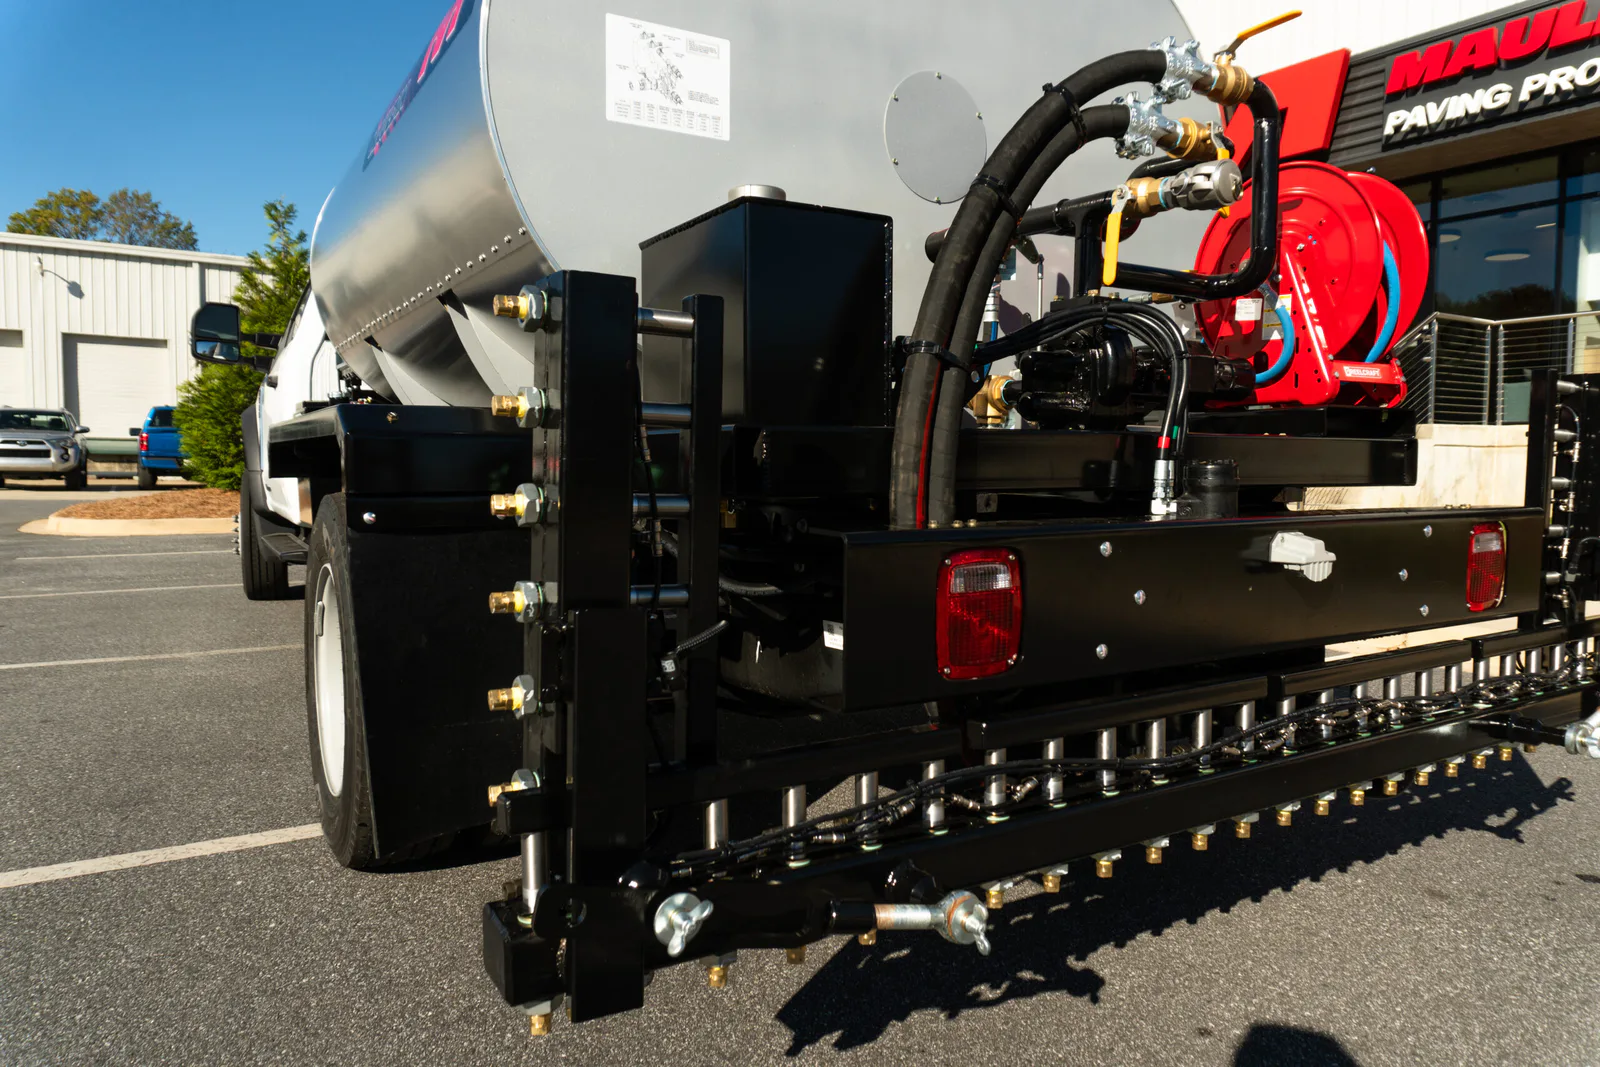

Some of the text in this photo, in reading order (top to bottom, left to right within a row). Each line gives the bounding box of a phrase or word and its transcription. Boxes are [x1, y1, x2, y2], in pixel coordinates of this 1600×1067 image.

[1385, 0, 1600, 95] MAUL
[1383, 57, 1600, 136] PAVING PRO
[1348, 367, 1381, 377] REELCRAFT
